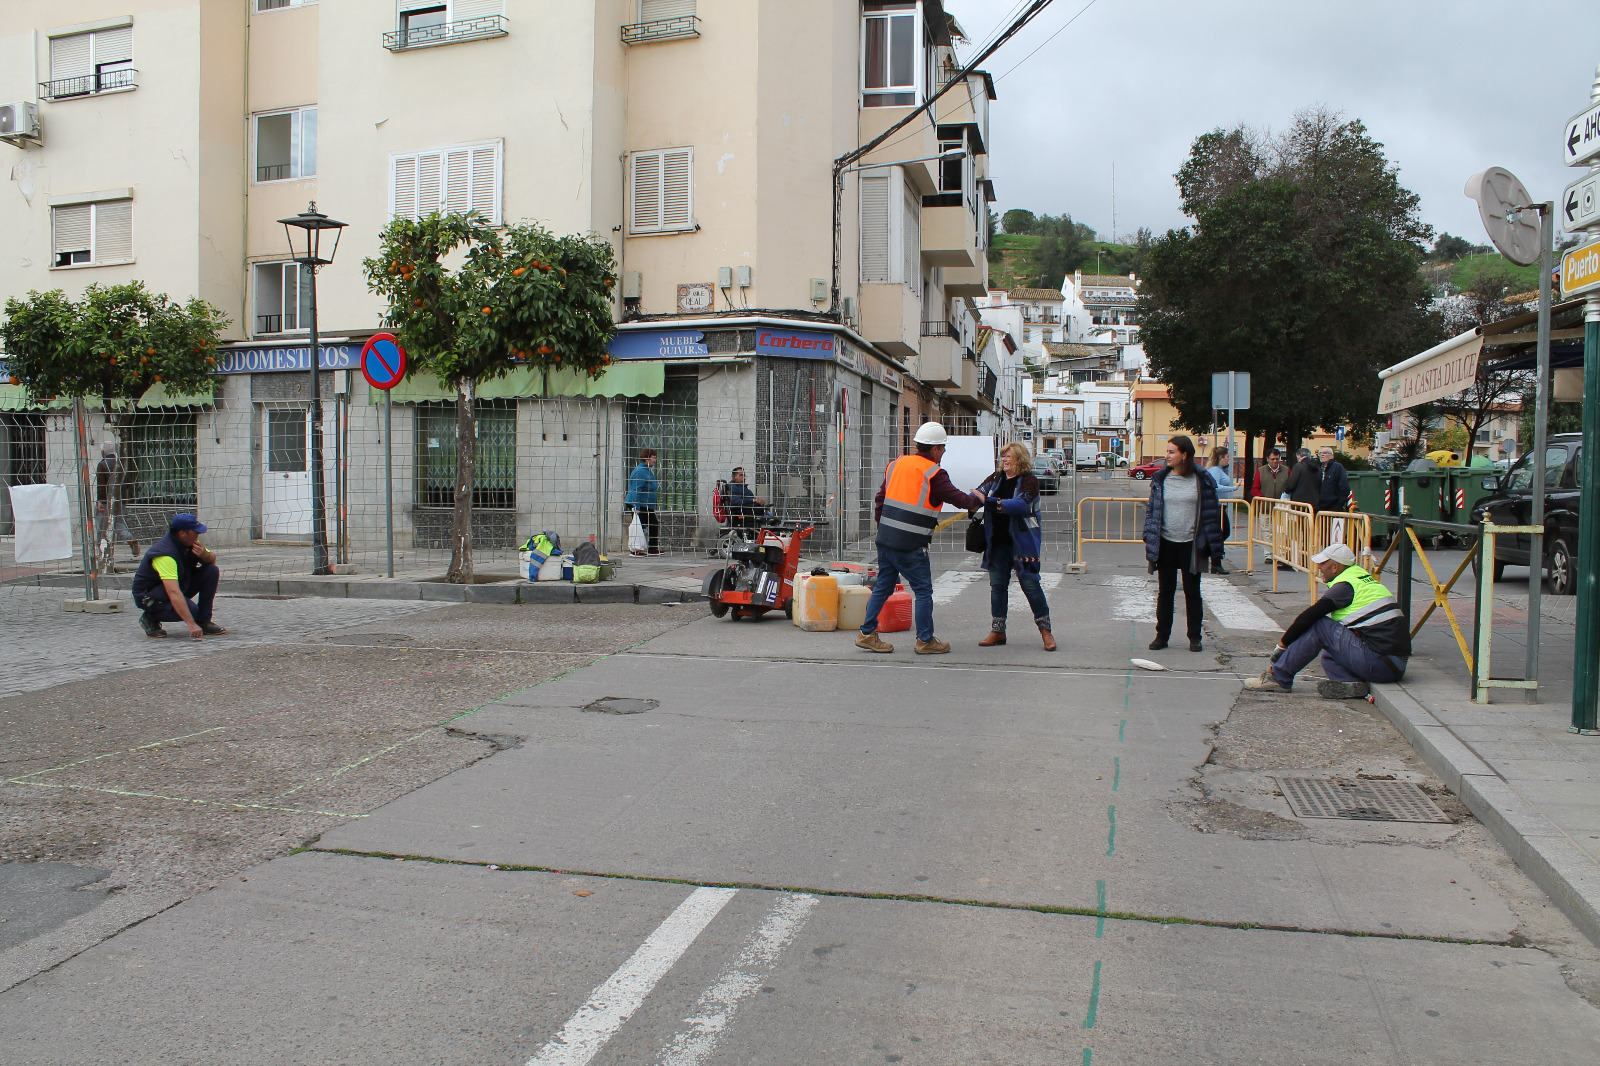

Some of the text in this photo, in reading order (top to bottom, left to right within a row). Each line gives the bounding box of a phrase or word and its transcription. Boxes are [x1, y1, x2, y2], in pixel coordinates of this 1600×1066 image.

[1567, 250, 1599, 282] Puerto
[685, 297, 703, 305] REAL
[759, 332, 833, 351] Corberó
[1403, 352, 1477, 399] LA CASITA DULCE
